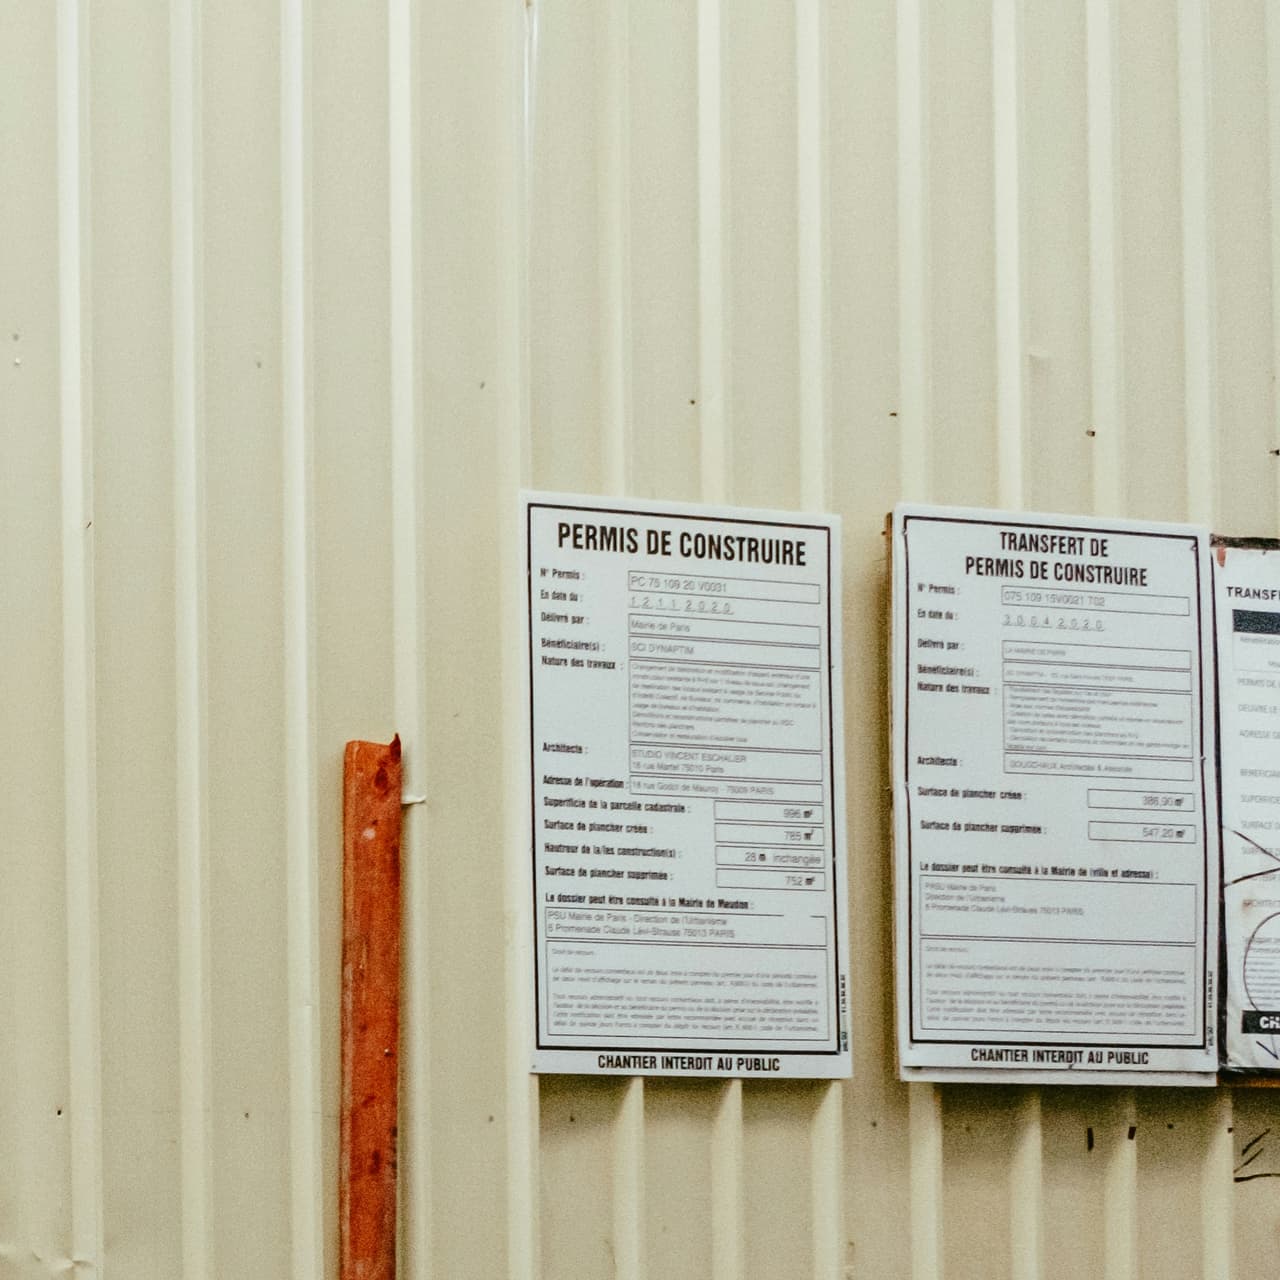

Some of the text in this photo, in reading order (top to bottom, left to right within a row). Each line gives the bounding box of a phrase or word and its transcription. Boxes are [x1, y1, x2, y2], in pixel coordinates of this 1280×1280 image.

[558, 523, 806, 566] PERMIS DE CONSTRUIRE
[1000, 532, 1109, 557] TRANSFERT DE
[966, 556, 1147, 586] PERMIS DE CONSTRUIRE
[1226, 586, 1280, 601] TRANSF
[598, 1054, 780, 1071] CHANTIER INTERDIT AU PUBLIC
[971, 1048, 1148, 1064] CHANTIER INTERDIT AU PUBLIC
